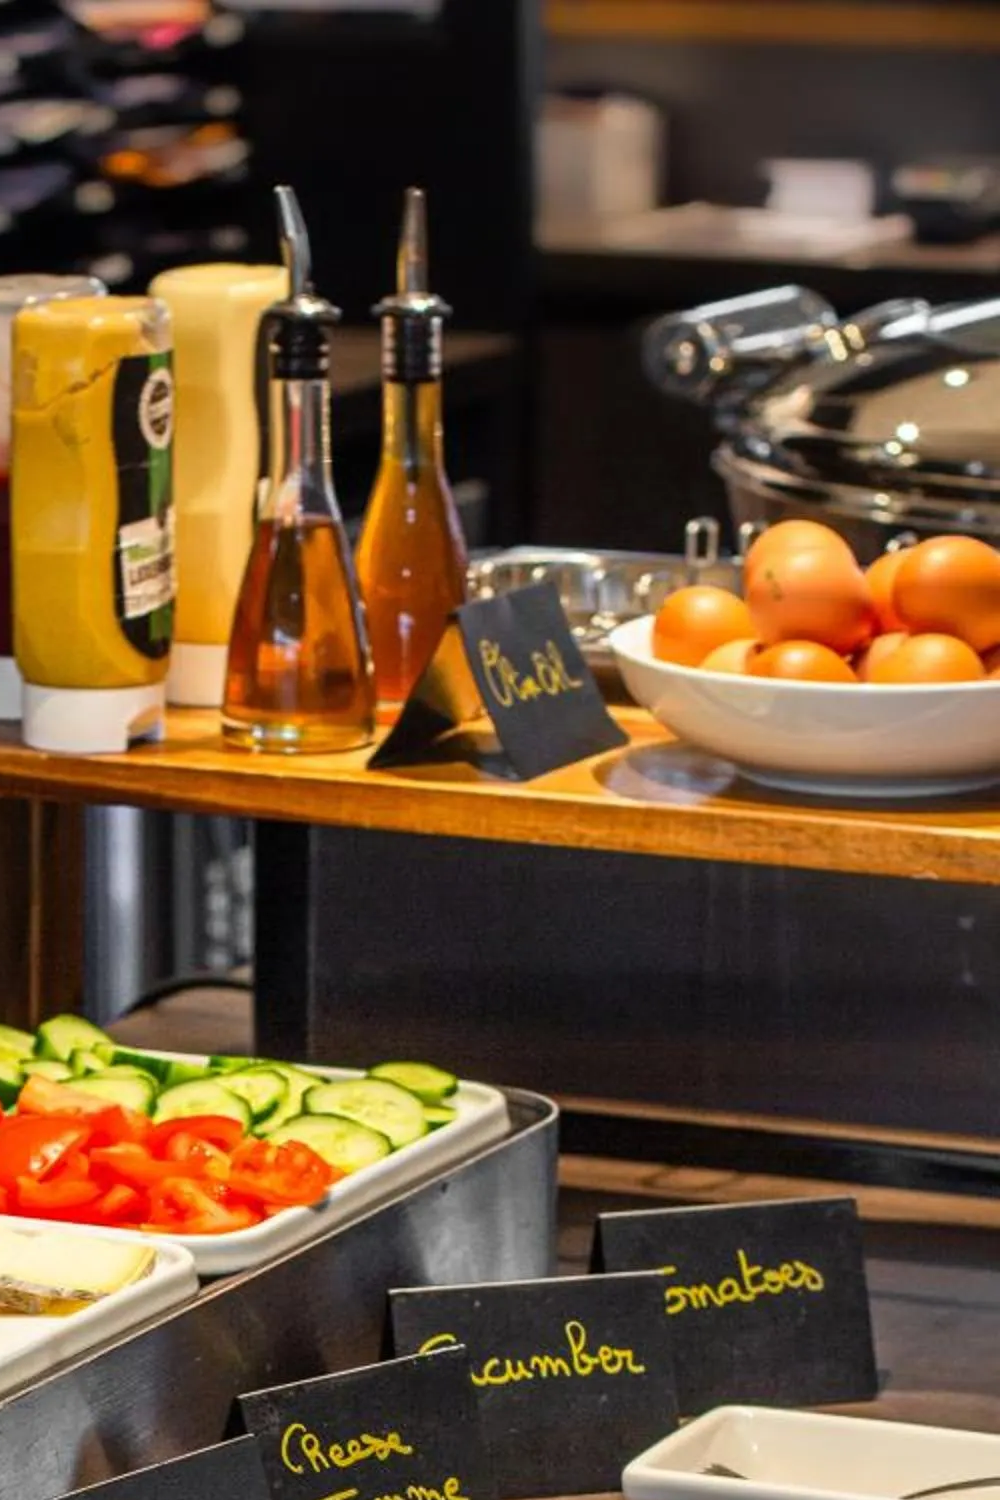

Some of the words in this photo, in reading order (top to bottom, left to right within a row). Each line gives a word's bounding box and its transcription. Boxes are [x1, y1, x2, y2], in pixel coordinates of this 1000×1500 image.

[663, 1248, 825, 1315] omatoes
[418, 1320, 646, 1387] cumber
[280, 1422, 413, 1475] Cheese
